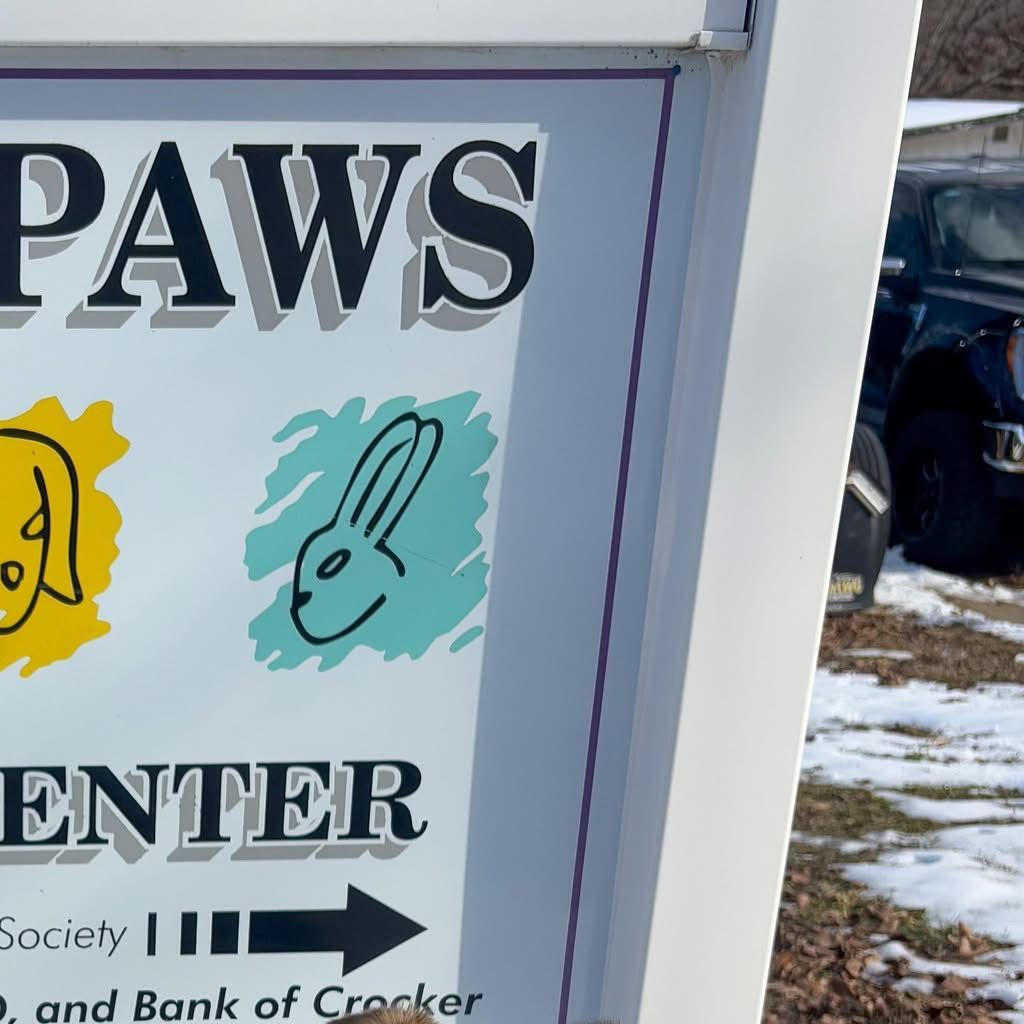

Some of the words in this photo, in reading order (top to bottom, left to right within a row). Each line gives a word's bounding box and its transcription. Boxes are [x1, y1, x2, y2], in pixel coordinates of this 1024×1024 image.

[35, 988, 119, 1024] and
[132, 986, 241, 1023] Bank
[253, 984, 302, 1020] of
